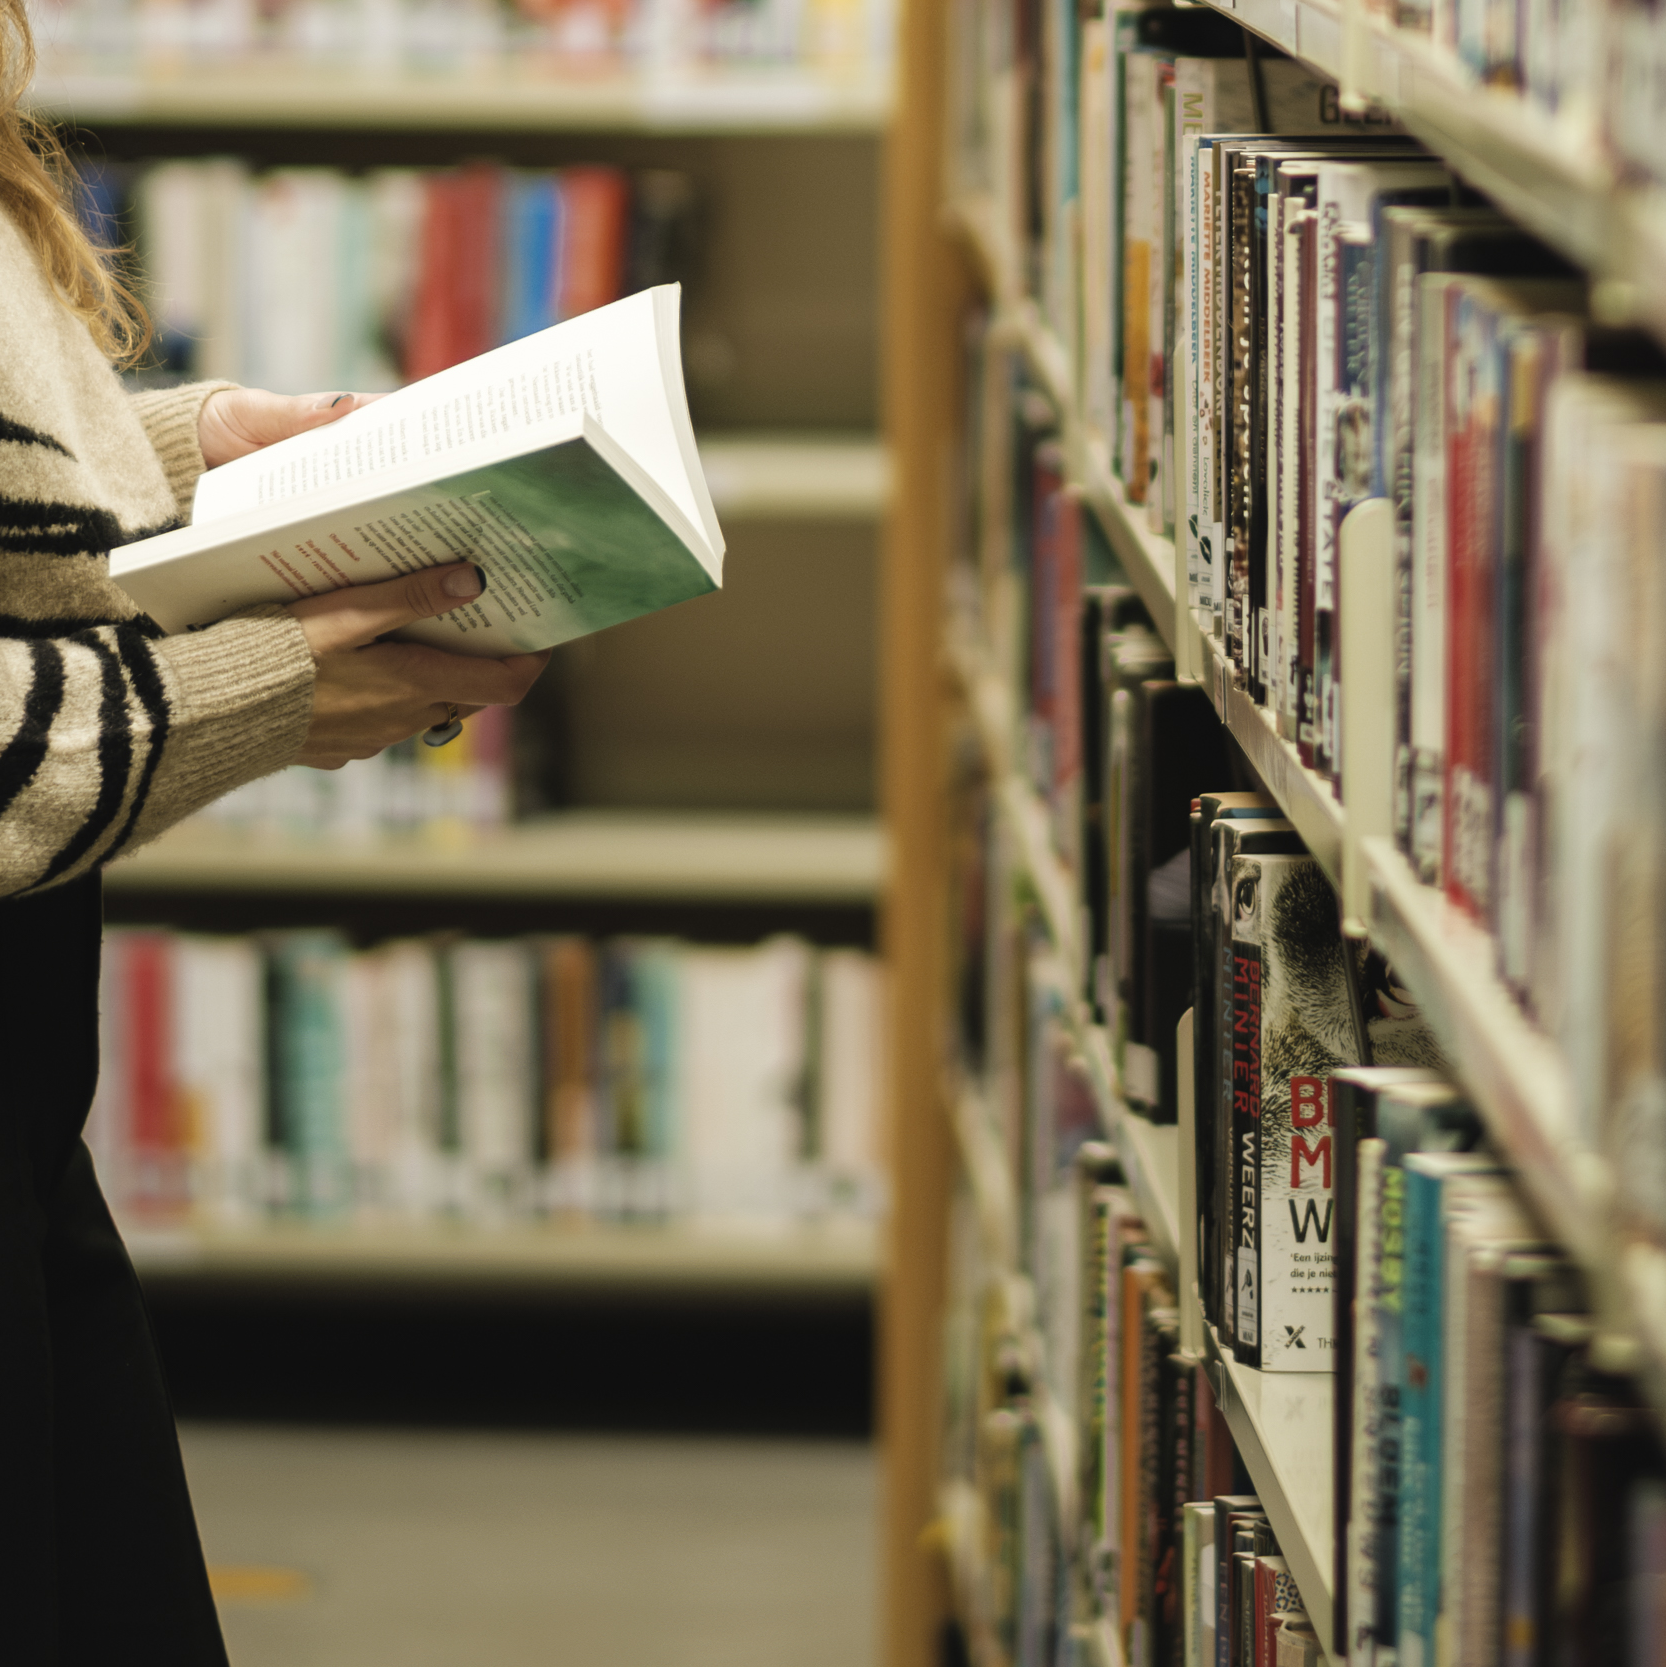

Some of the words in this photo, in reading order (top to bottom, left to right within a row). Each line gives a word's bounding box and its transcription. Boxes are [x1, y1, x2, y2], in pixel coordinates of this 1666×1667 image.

[1203, 170, 1213, 261] MARIËTTE
[1203, 267, 1211, 384] MIDDELBEEK
[1233, 956, 1249, 1113] MINIER
[1241, 1131, 1256, 1248] WEERZ
[1248, 960, 1260, 1119] BERNARD
